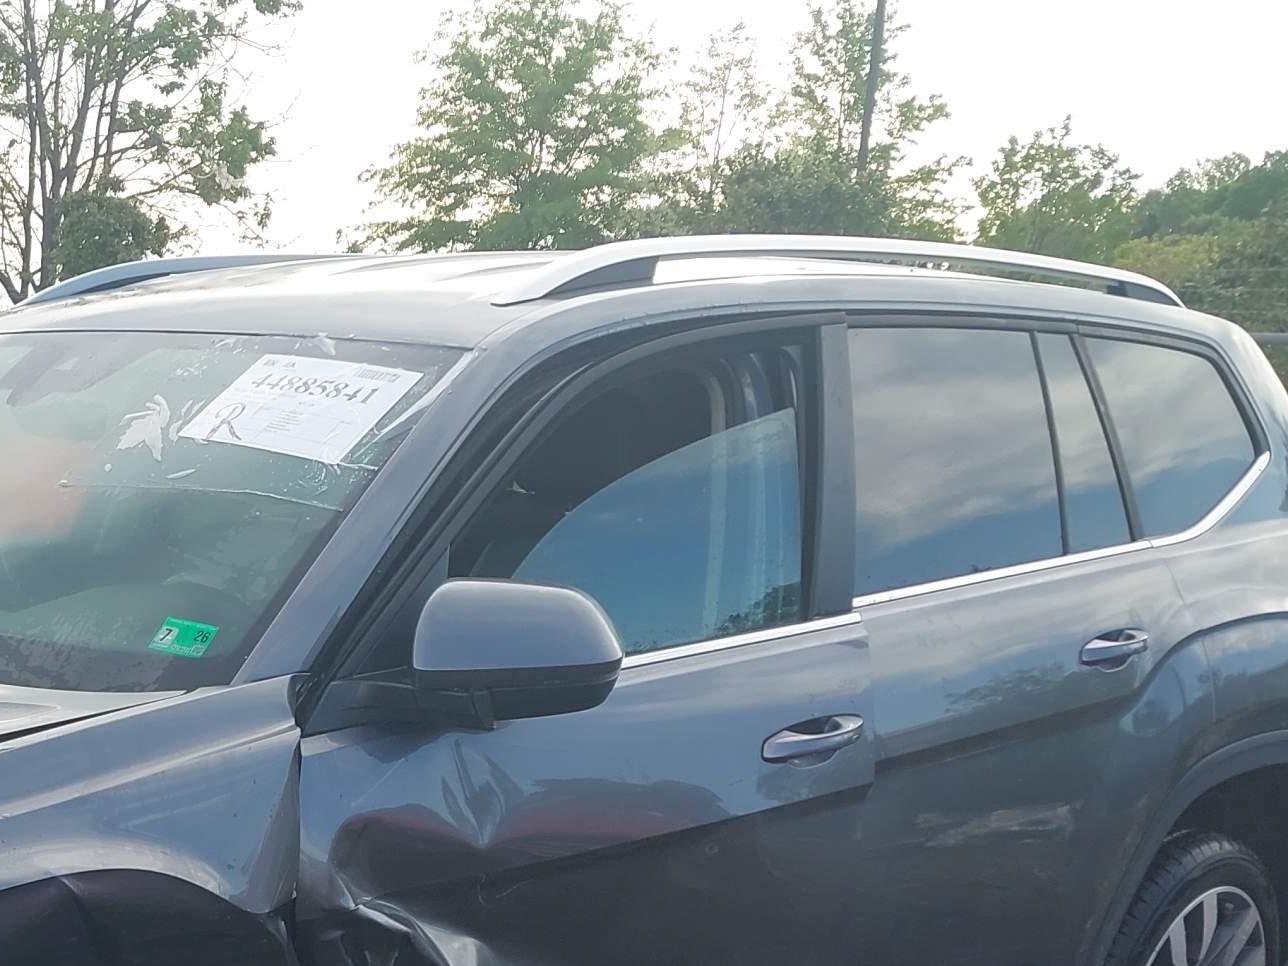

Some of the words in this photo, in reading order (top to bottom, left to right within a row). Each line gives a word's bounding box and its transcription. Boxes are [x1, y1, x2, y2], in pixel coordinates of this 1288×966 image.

[251, 373, 379, 404] 44885841
[205, 402, 246, 441] R
[159, 628, 173, 642] 7
[193, 630, 211, 643] 26
